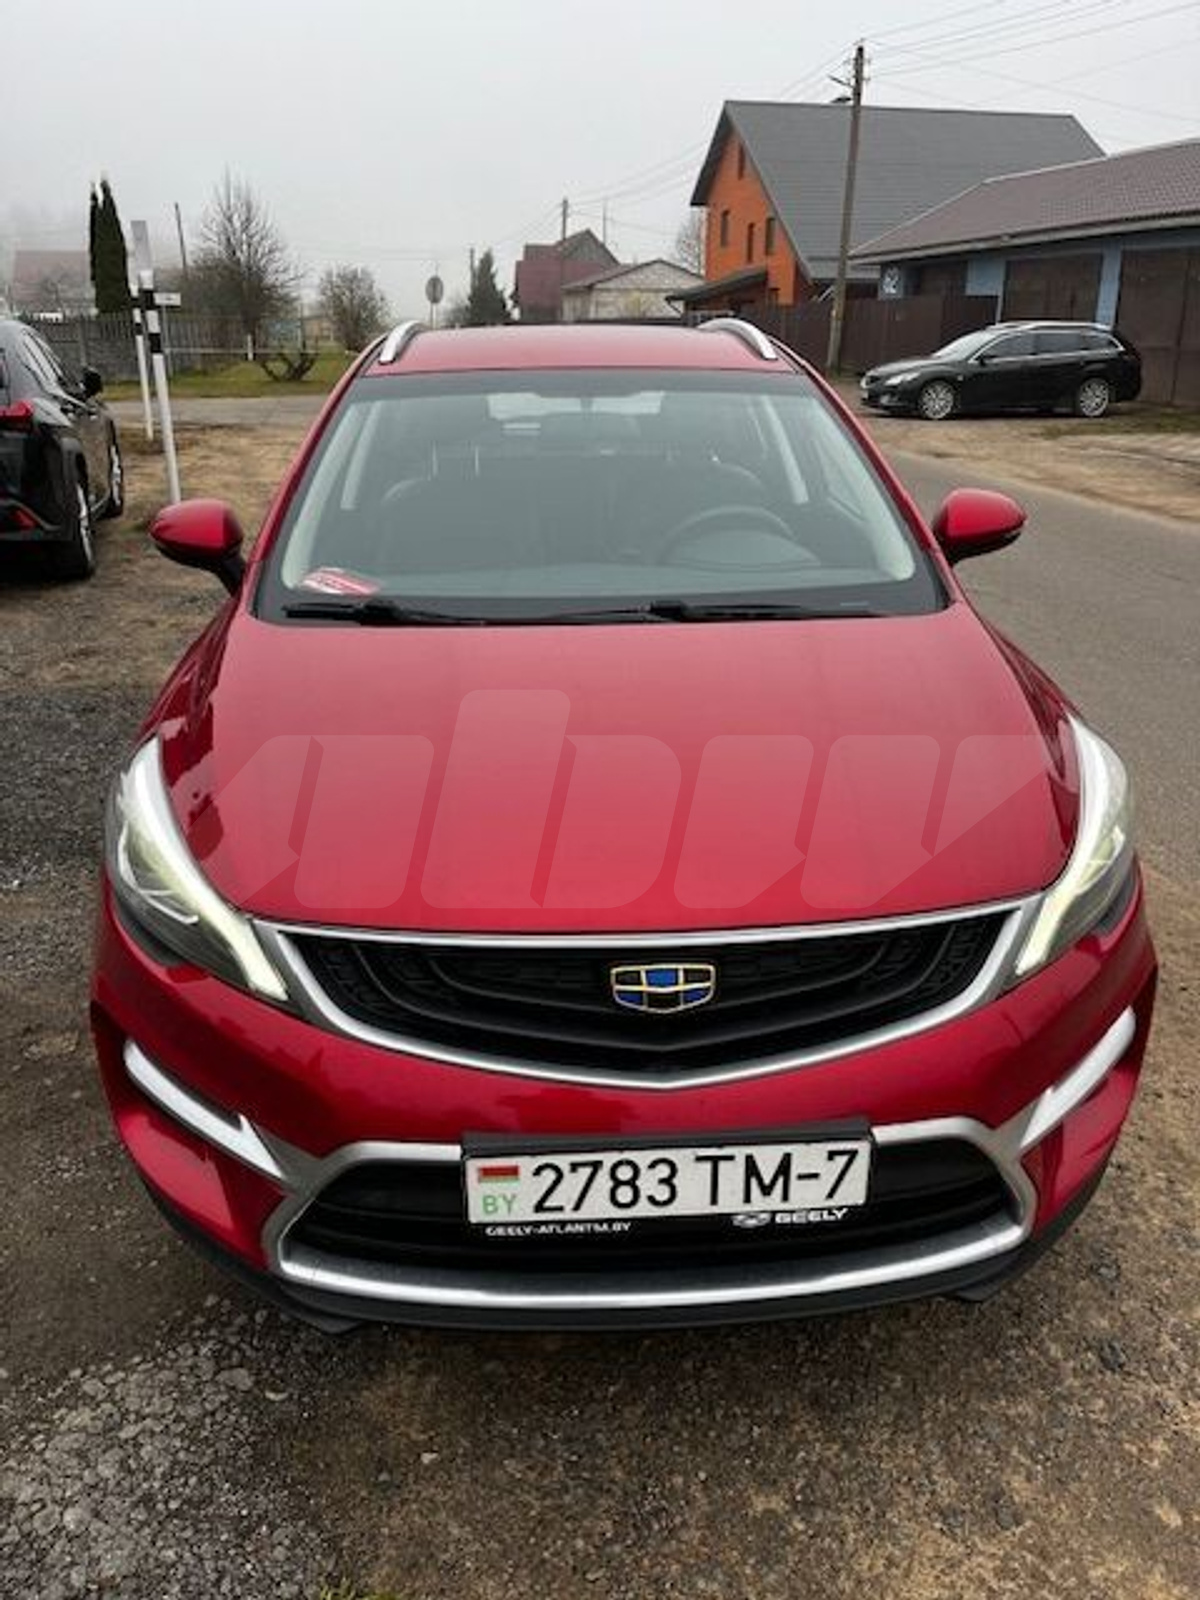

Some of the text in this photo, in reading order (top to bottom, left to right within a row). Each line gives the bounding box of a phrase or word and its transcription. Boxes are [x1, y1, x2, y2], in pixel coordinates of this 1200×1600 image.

[532, 1149, 859, 1214] 2783 TM-7
[483, 1195, 517, 1215] BY
[775, 1207, 848, 1224] GEELY
